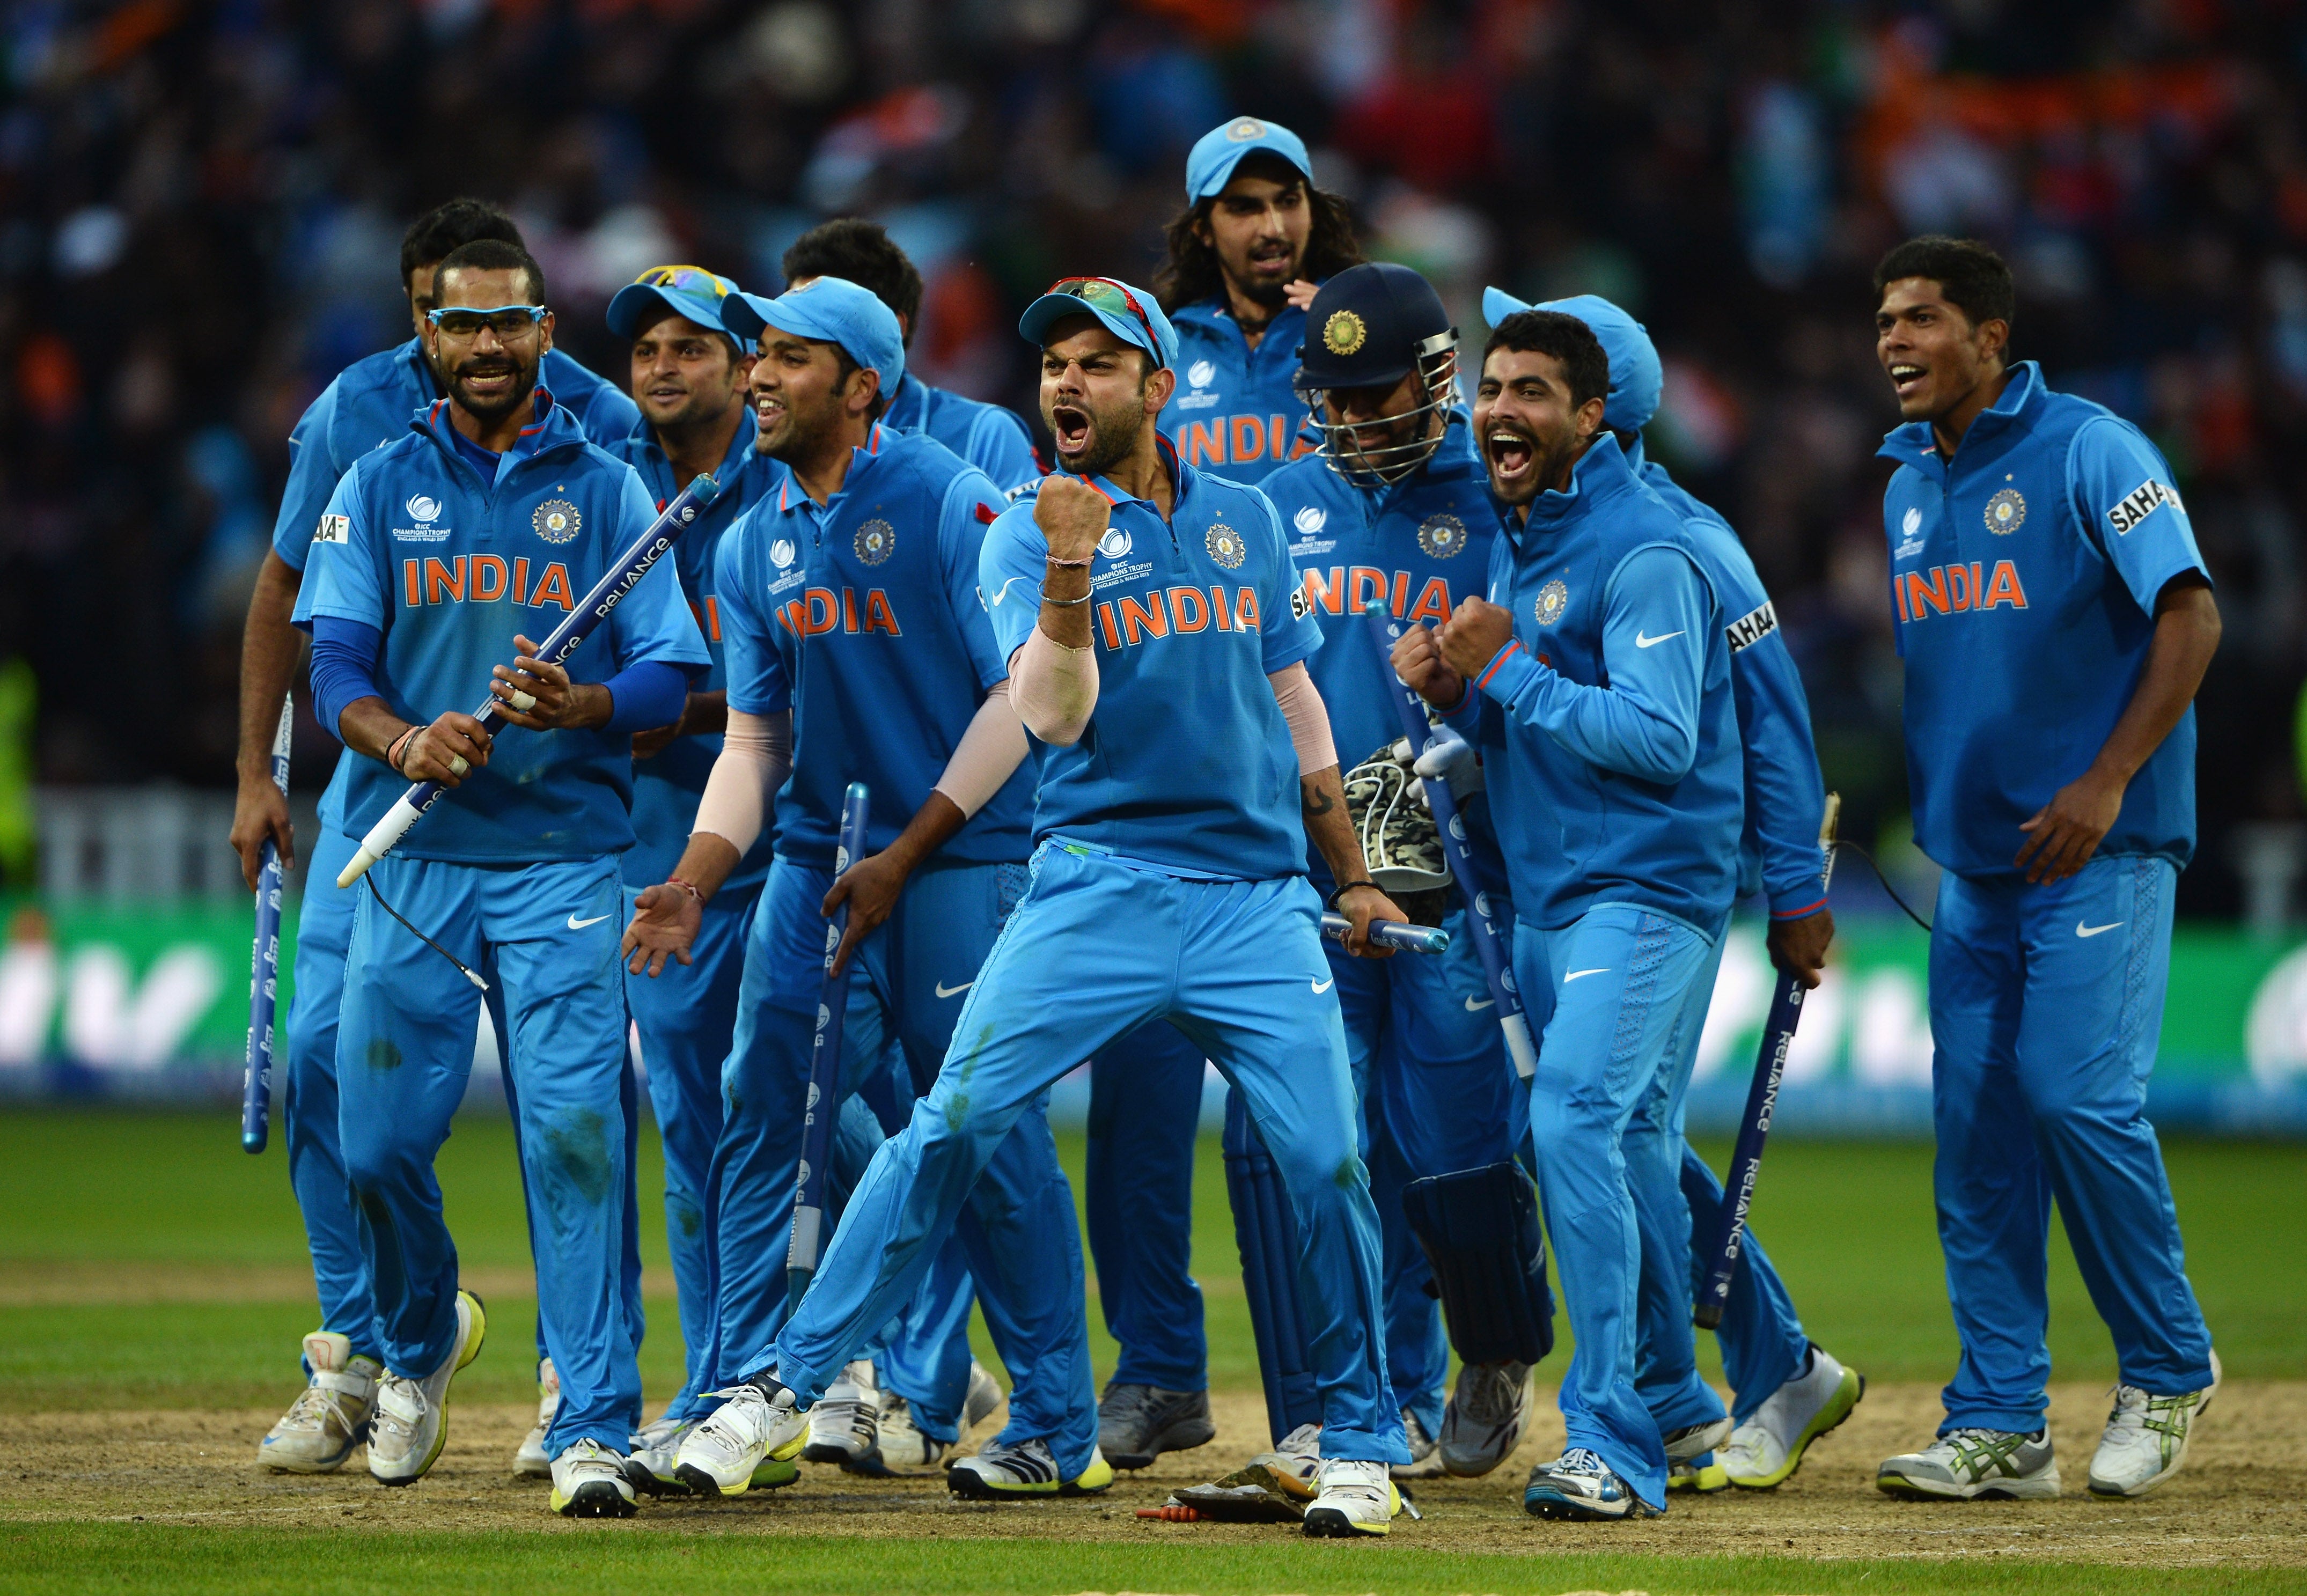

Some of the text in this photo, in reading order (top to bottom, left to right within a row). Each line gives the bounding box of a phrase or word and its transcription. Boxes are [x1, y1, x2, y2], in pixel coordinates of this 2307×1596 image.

[403, 554, 576, 613] INDIA
[1096, 579, 1119, 590] ENGLAND
[1124, 573, 1140, 582] WALES
[1118, 560, 1128, 569] ICC
[1128, 562, 1153, 573] TROPHY
[1894, 560, 2029, 624] INDIA
[1097, 586, 1260, 651] INDIA
[1303, 565, 1453, 627] NDIA
